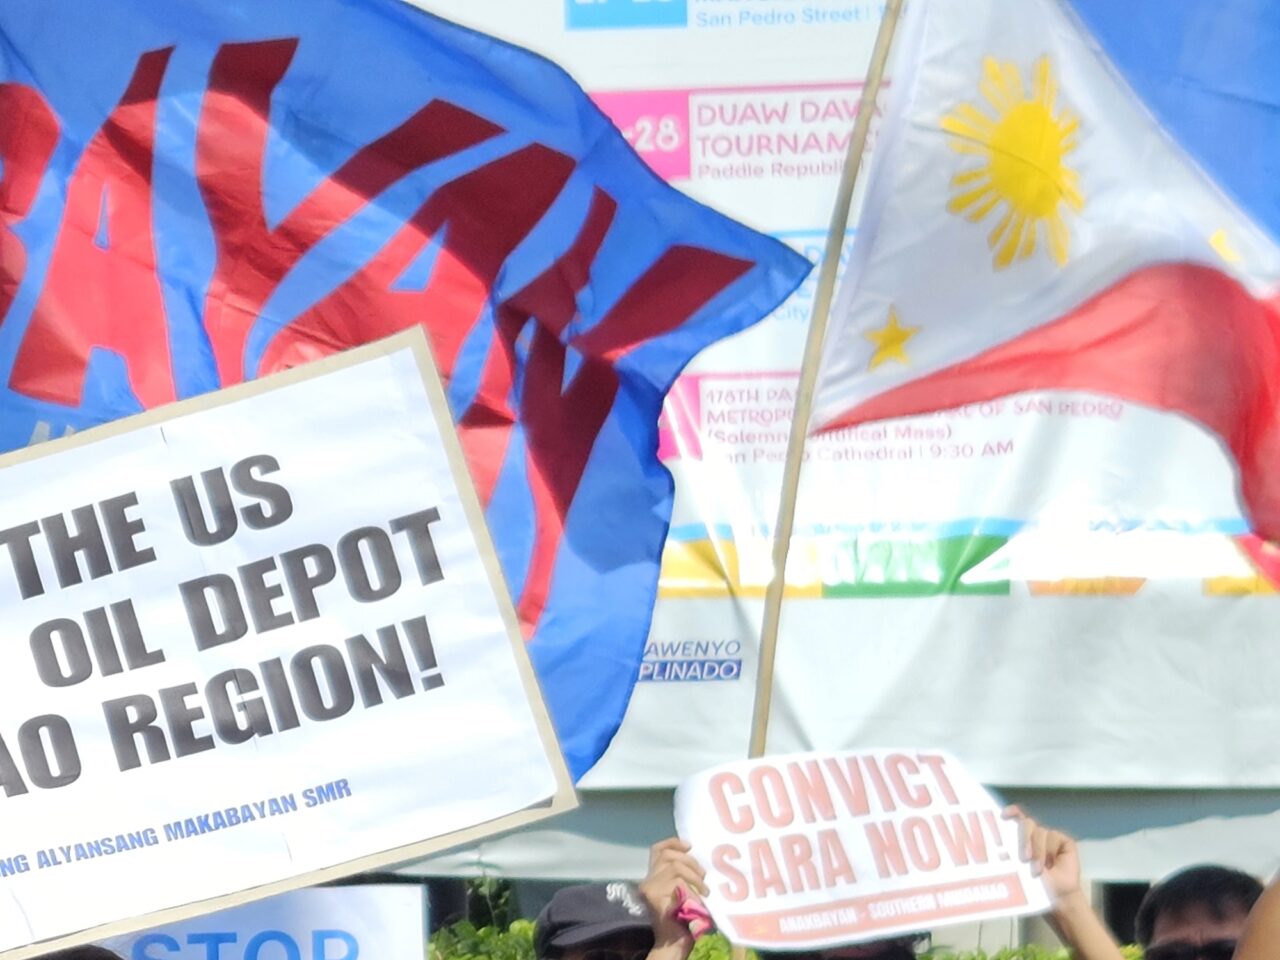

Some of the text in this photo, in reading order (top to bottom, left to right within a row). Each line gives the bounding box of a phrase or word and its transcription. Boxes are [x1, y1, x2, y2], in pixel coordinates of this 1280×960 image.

[697, 11, 732, 28] San
[738, 8, 795, 26] Pedro
[802, 5, 860, 24] Street
[697, 101, 788, 127] DUAW
[698, 159, 844, 180] Paddle Republi
[980, 439, 1015, 456] AM
[1013, 398, 1053, 416] SAN
[168, 452, 295, 551] US
[30, 596, 166, 689] OIL
[178, 505, 445, 652] DEPOT
[101, 613, 445, 772] REGION!
[36, 827, 160, 869] ALYANSANG
[163, 793, 298, 842] MAKABAYAN
[302, 778, 352, 809] SMR
[708, 753, 961, 835] CONVICT
[710, 827, 859, 902] SARA
[865, 809, 1012, 886] NOW!
